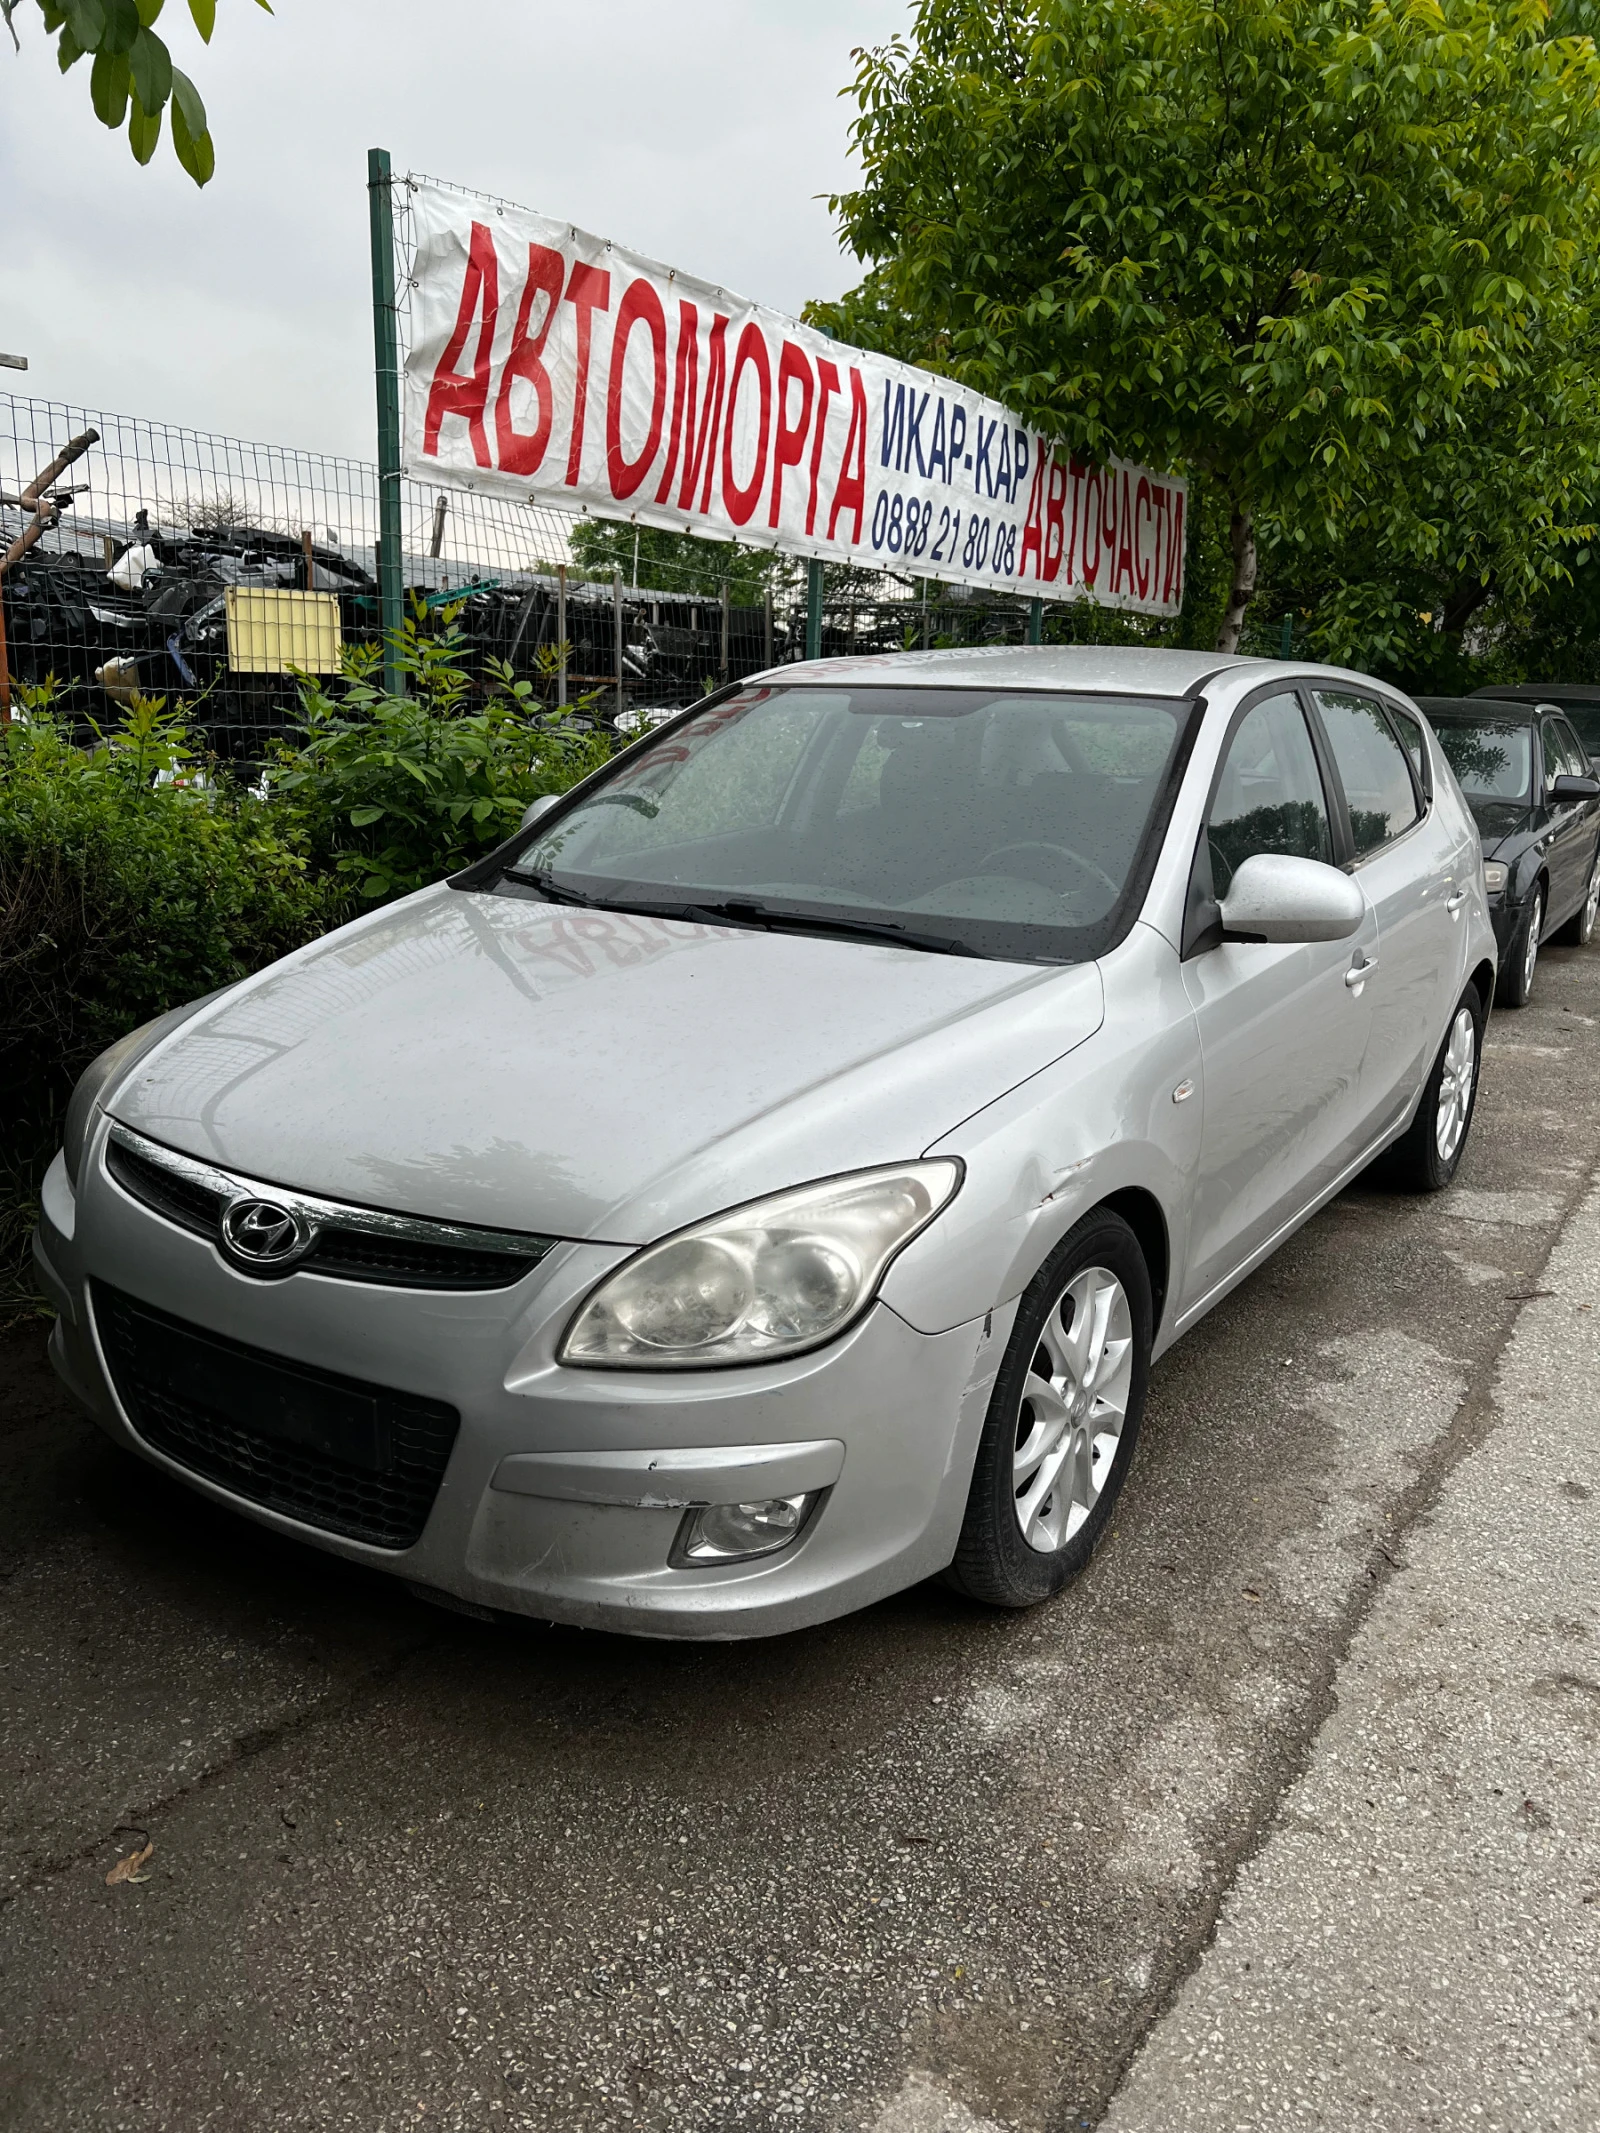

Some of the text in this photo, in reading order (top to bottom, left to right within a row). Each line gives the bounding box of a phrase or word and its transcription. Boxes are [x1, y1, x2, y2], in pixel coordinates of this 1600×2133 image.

[423, 220, 867, 544] АВТОМОРГА
[881, 378, 1029, 504] ИКАР-КАР
[872, 489, 1017, 576] 0888 21 80 08
[1017, 436, 1184, 605] АВТОЧАСТИ
